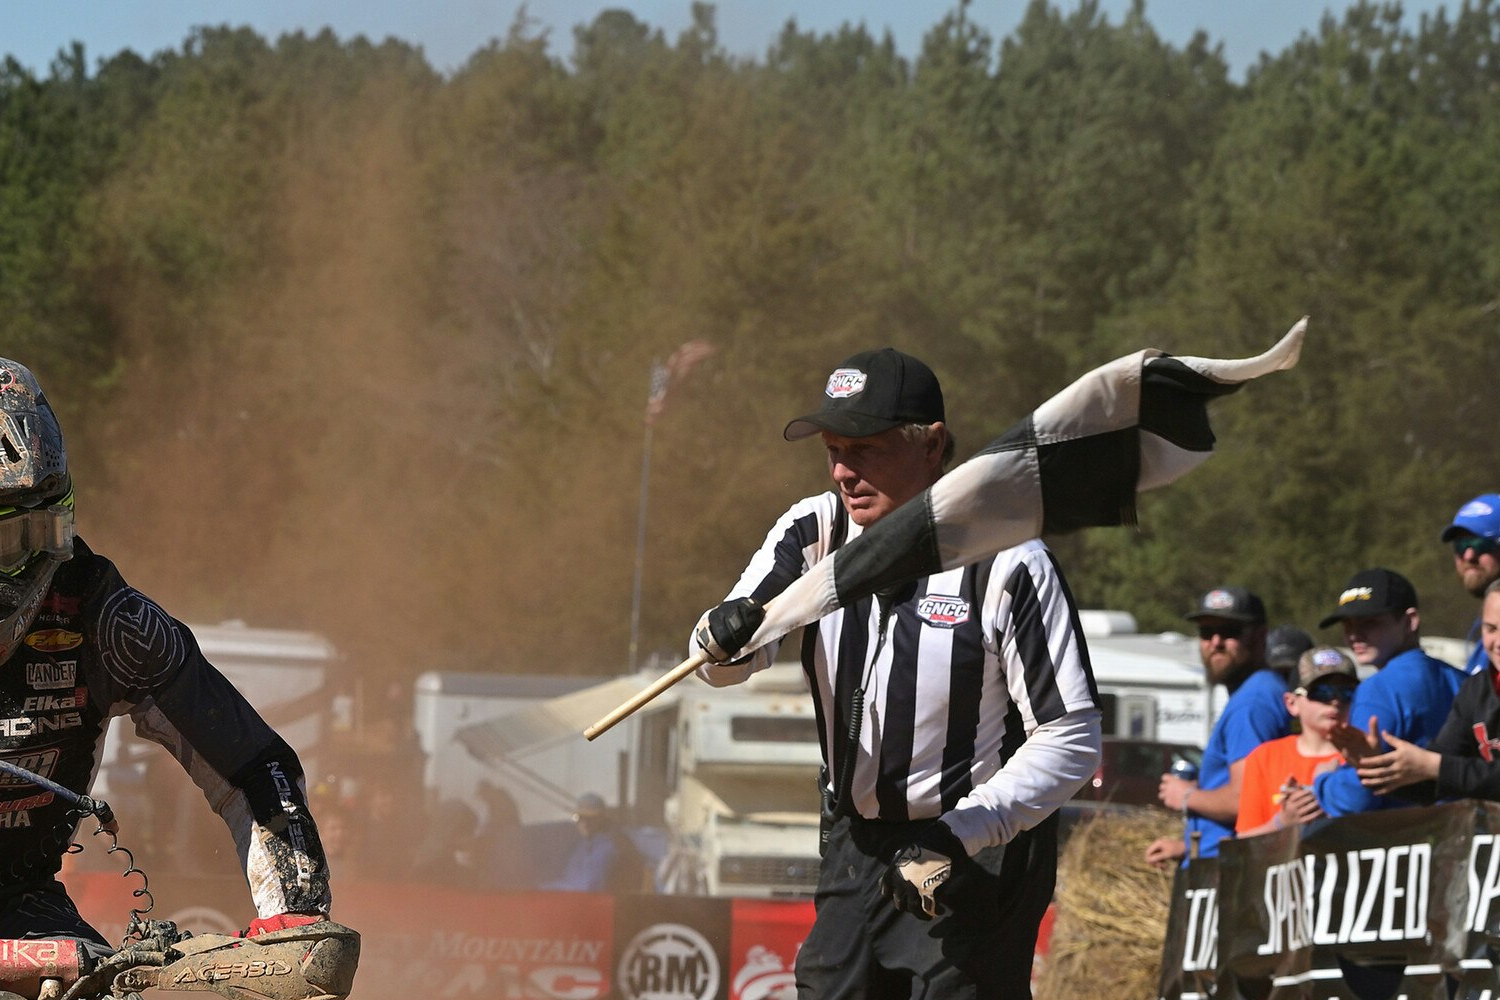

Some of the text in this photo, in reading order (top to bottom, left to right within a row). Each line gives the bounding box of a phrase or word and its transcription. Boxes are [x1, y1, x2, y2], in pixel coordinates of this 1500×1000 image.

[919, 601, 968, 618] GNCC
[24, 695, 76, 712] Elka
[174, 960, 293, 984] ACERBIS
[639, 953, 701, 996] RM
